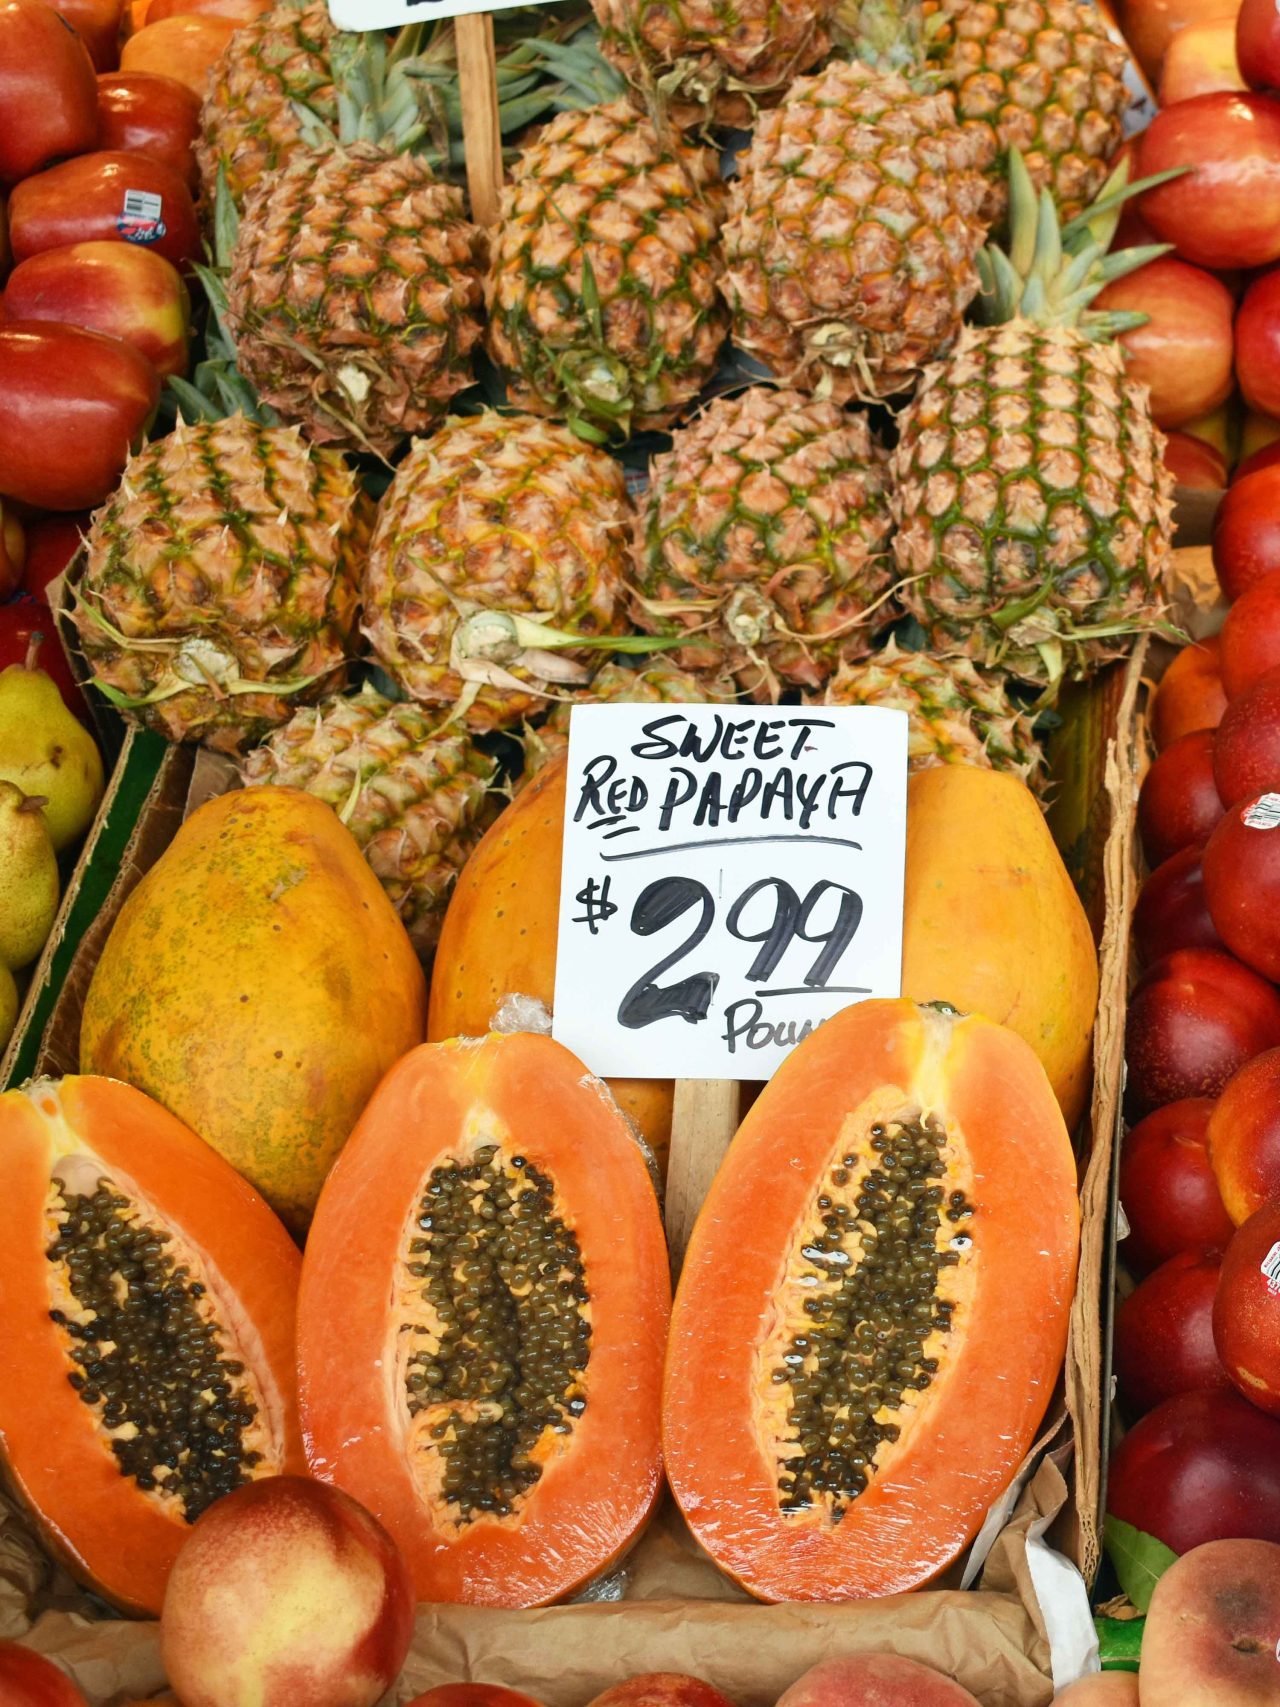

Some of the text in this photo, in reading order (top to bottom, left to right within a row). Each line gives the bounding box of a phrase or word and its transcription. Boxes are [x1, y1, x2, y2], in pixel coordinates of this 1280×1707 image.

[630, 713, 836, 763] SWEET
[572, 754, 874, 832] RED PAPAYA
